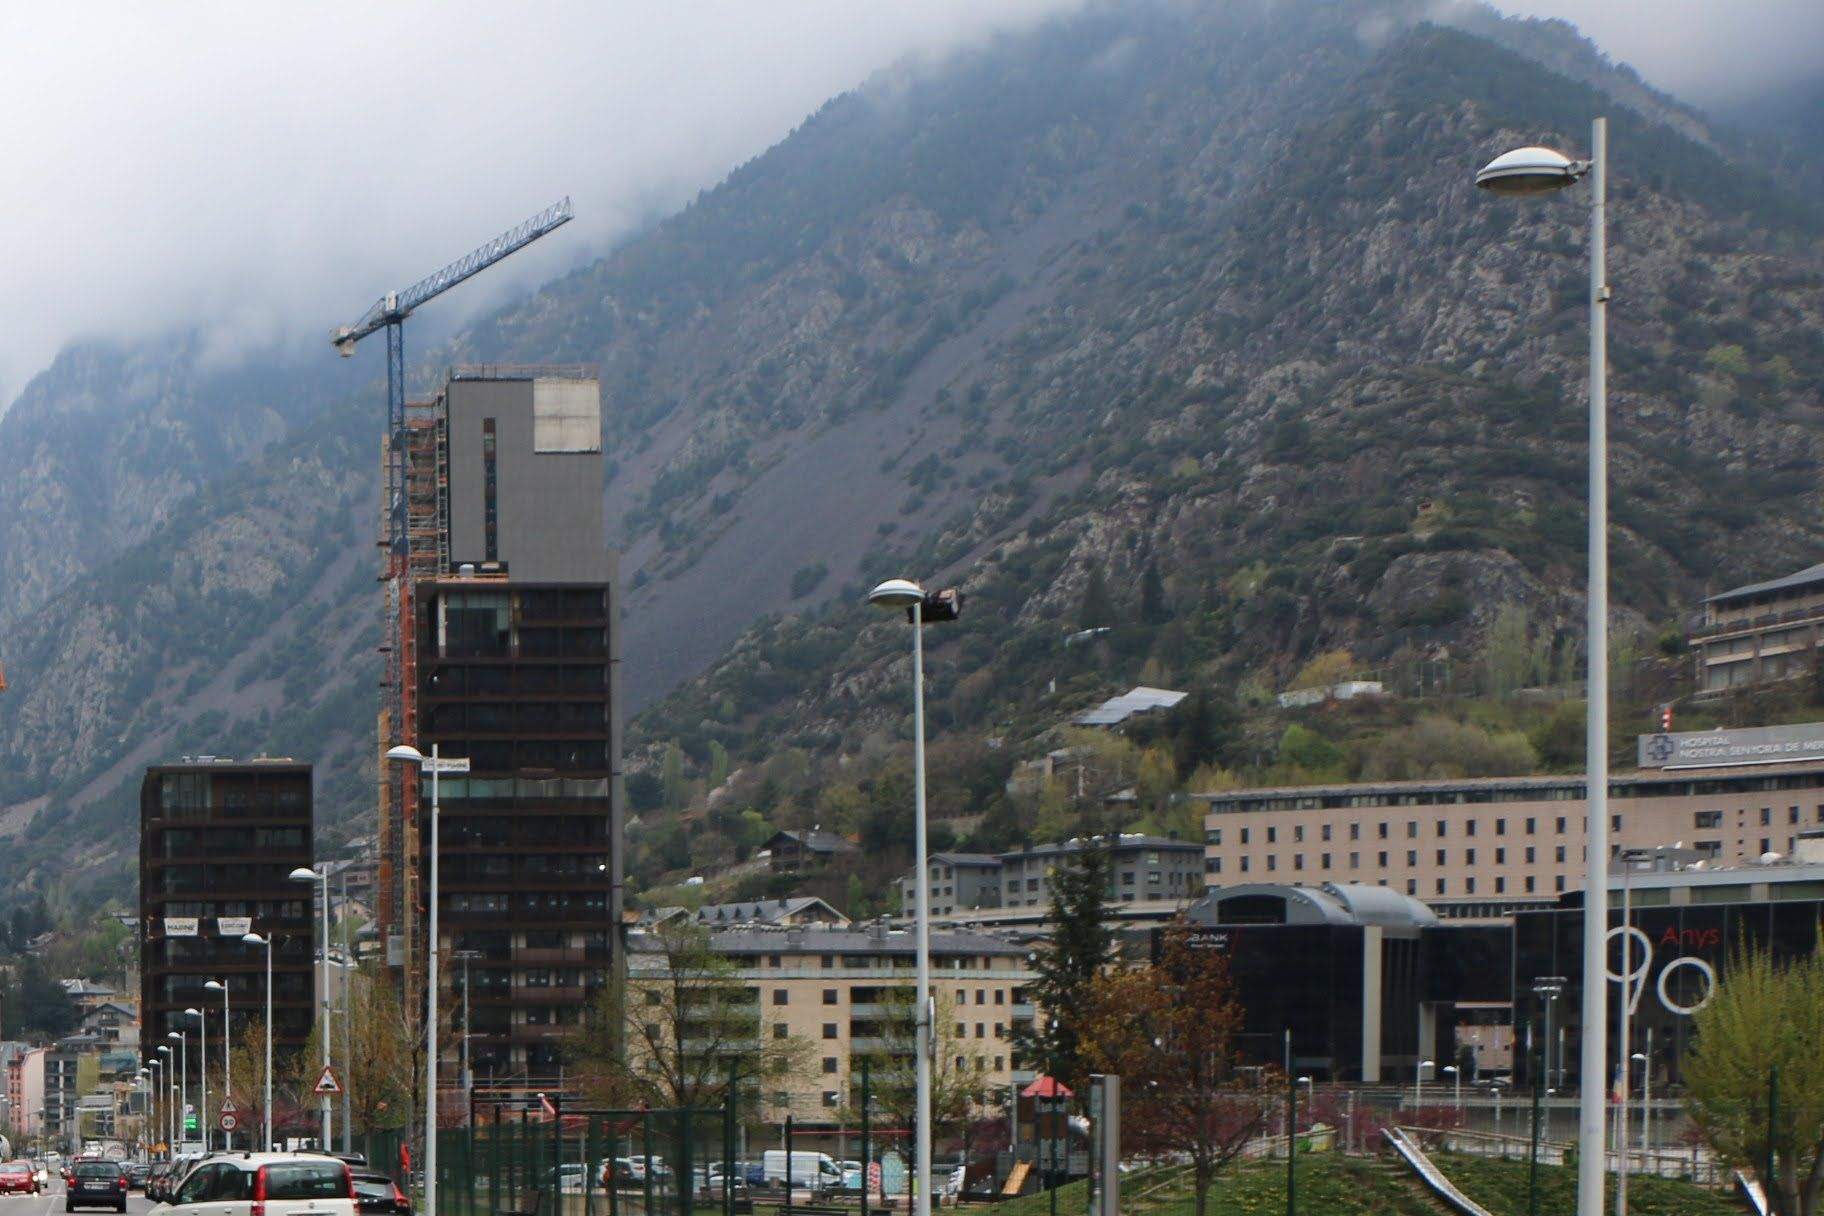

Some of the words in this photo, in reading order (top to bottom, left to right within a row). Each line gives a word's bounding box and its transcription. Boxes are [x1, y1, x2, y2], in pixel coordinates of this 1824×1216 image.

[1679, 736, 1730, 748] HOSPITAL
[1679, 748, 1725, 759] NOSTRA
[1784, 743, 1800, 752] DE
[1660, 926, 1721, 950] Anys
[1605, 926, 1715, 1015] 90
